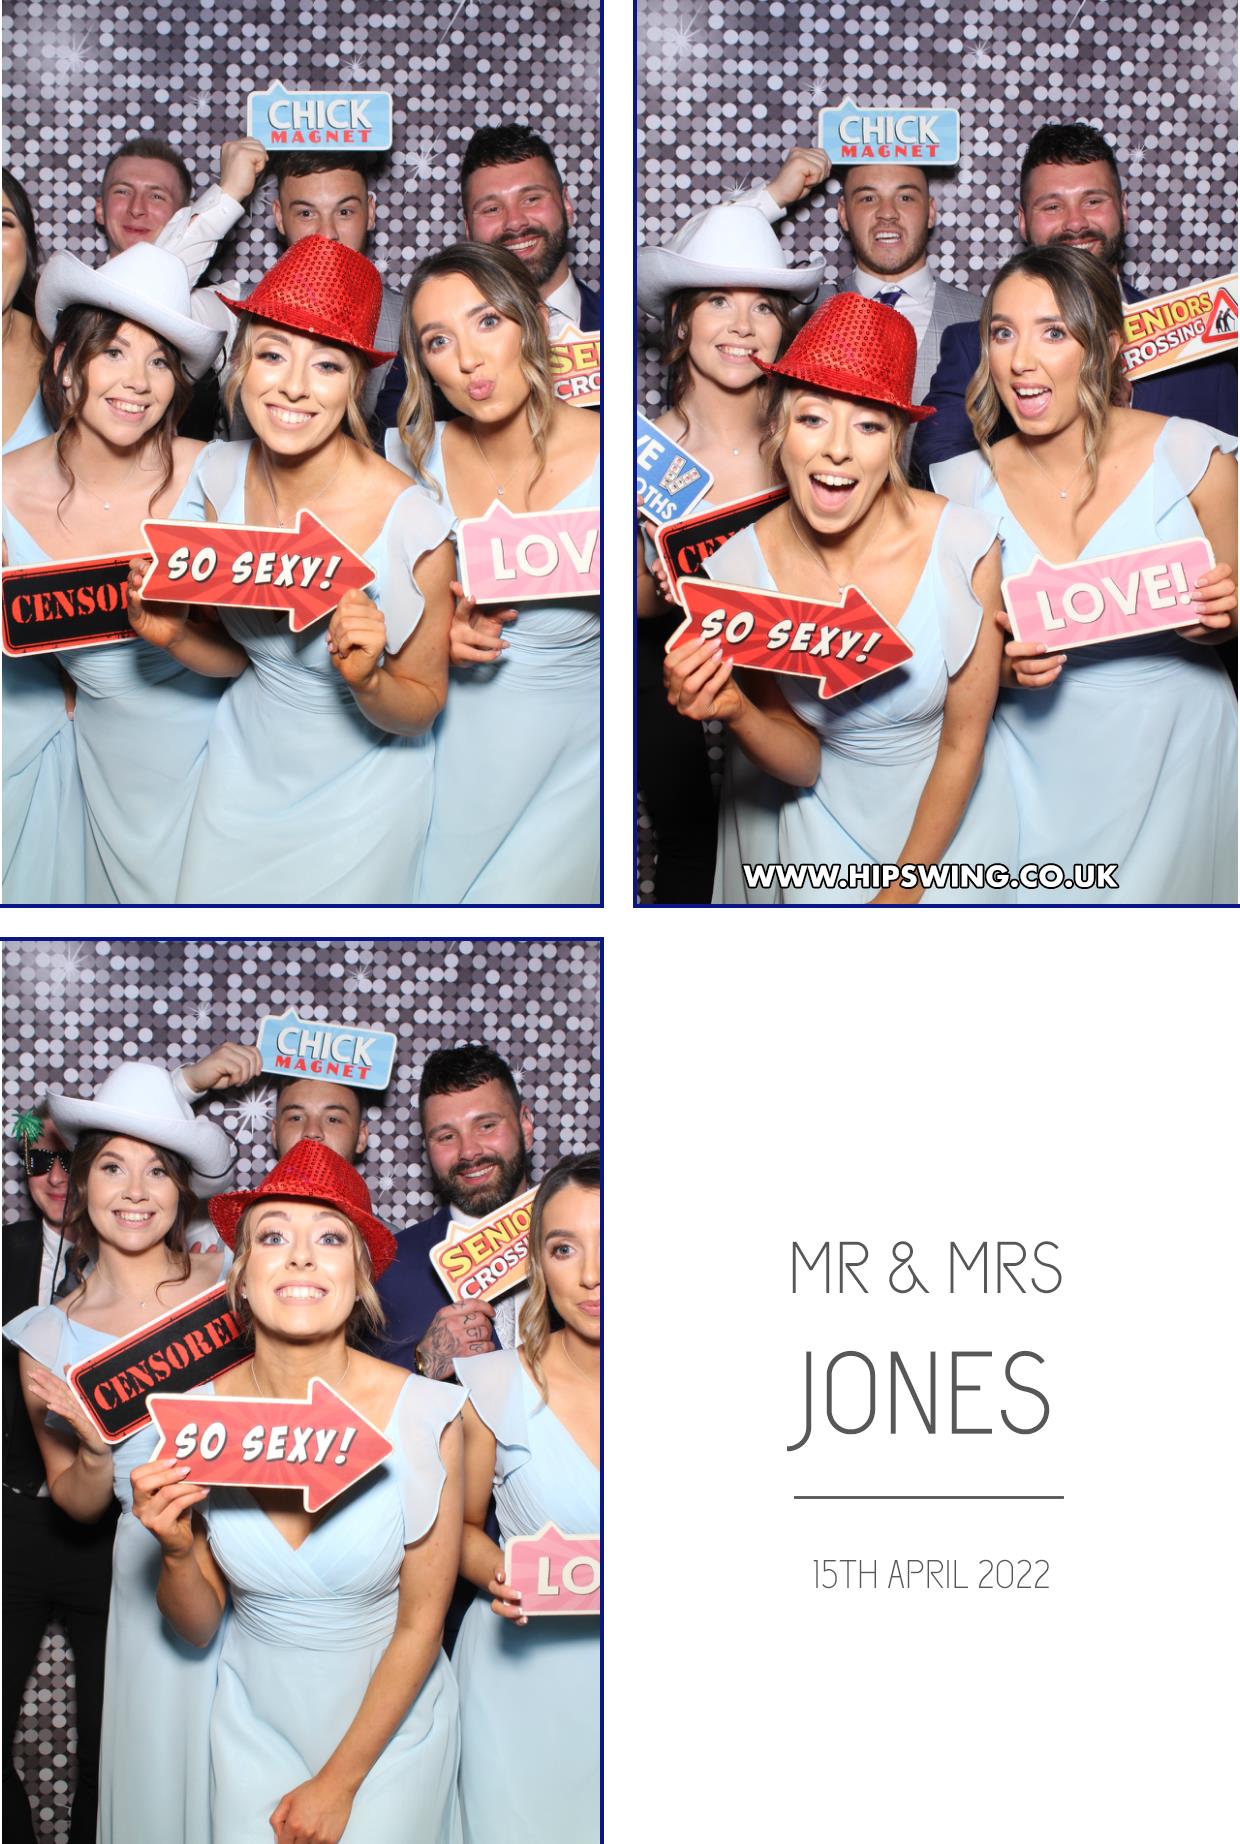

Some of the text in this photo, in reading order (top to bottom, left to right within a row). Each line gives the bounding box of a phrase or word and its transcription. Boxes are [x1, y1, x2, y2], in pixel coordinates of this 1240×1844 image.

[268, 99, 373, 130] CHICK
[839, 115, 940, 145] CHICK
[271, 130, 372, 144] MAGNET
[841, 145, 939, 158] MAGNET
[1123, 293, 1213, 343] ENIORS
[549, 342, 600, 374] SE
[167, 547, 342, 590] SO SEXY!
[490, 528, 599, 581] LOV
[1036, 562, 1192, 631] LOVE!
[700, 609, 882, 664] SO SEXY!
[277, 1026, 376, 1066] CHICK
[275, 1055, 371, 1080] MAGNET
[175, 1422, 356, 1466] SO SEXY!
[538, 1556, 600, 1596] LO
